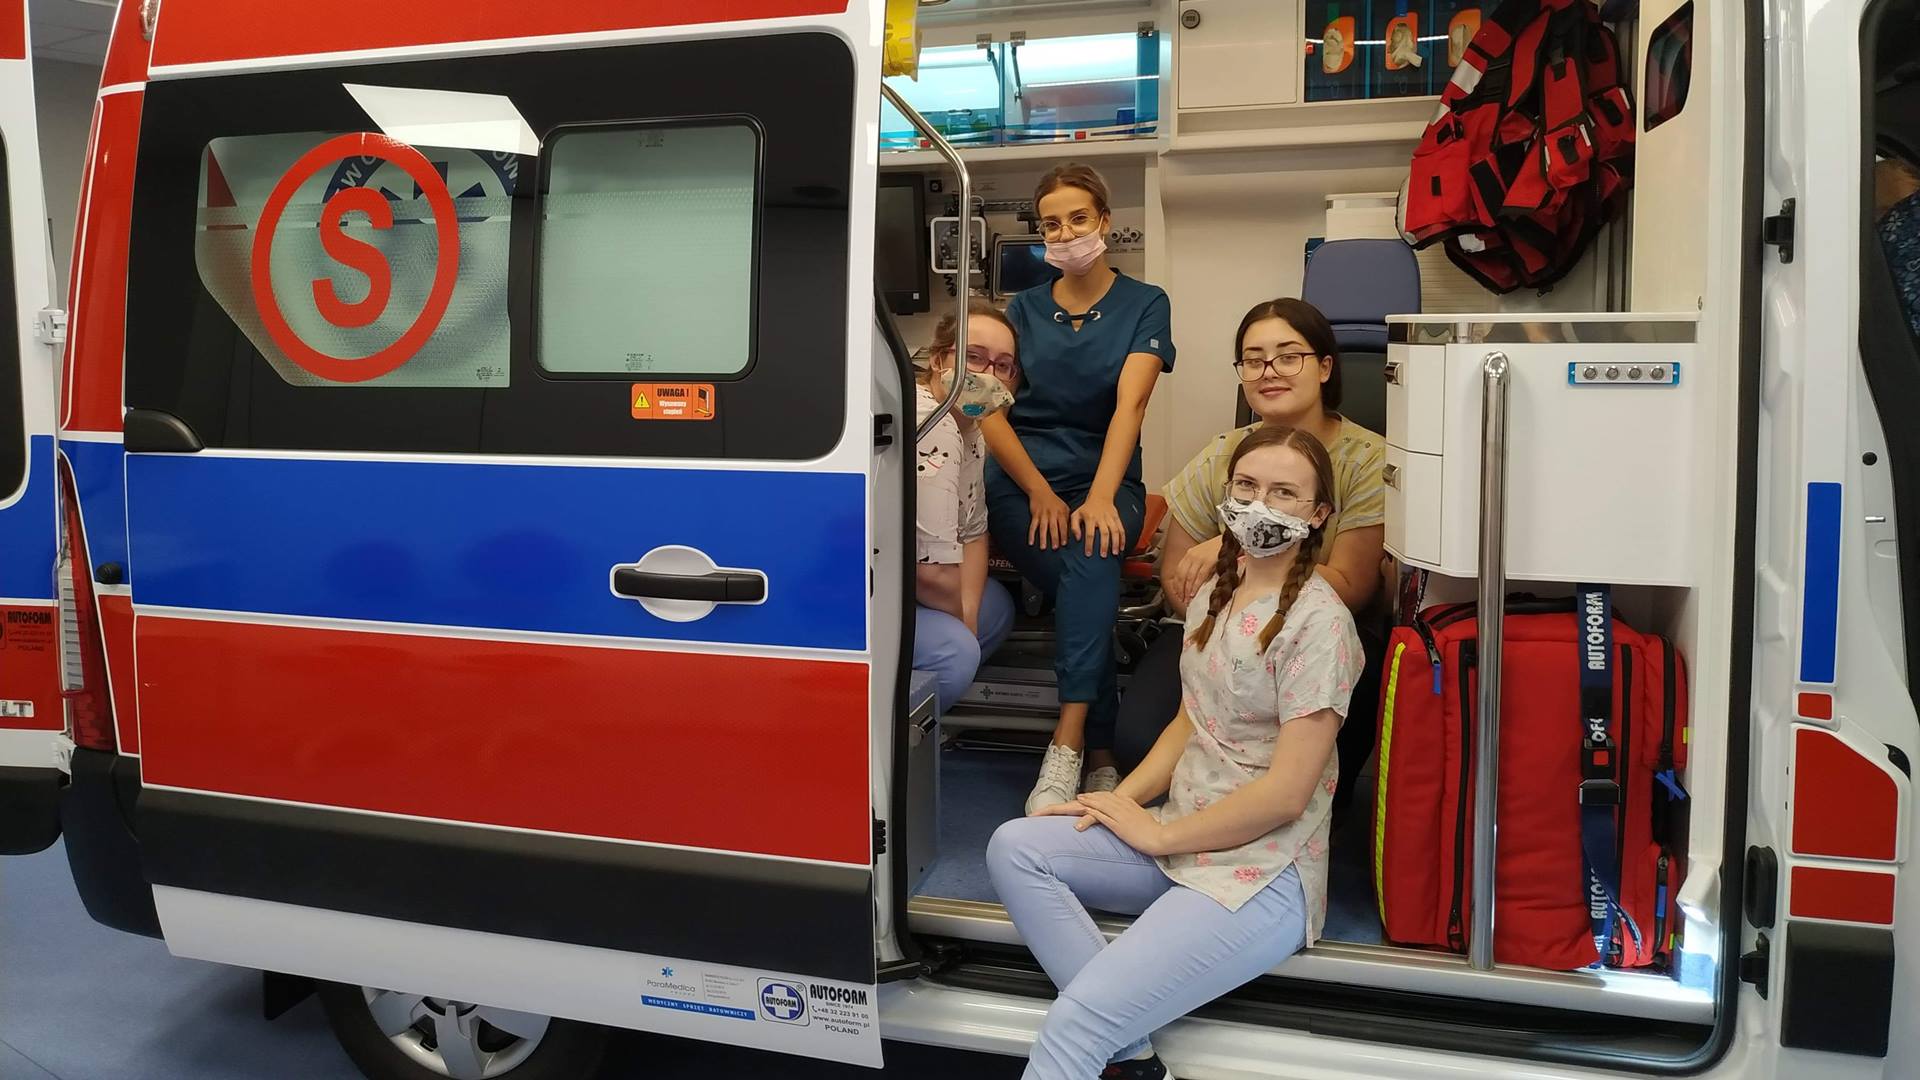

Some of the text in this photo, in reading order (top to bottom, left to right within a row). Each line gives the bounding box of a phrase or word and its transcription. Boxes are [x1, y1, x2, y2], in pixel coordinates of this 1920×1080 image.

[311, 186, 394, 329] S
[657, 388, 685, 397] UWAGA
[1586, 591, 1606, 670] AUTOFORM
[647, 979, 696, 992] ParaMedica
[810, 984, 867, 1005] AUTOFORM
[765, 997, 797, 1007] AUTOFORM
[812, 1015, 870, 1028] www.autoform.pl
[825, 1025, 859, 1035] POLAND
